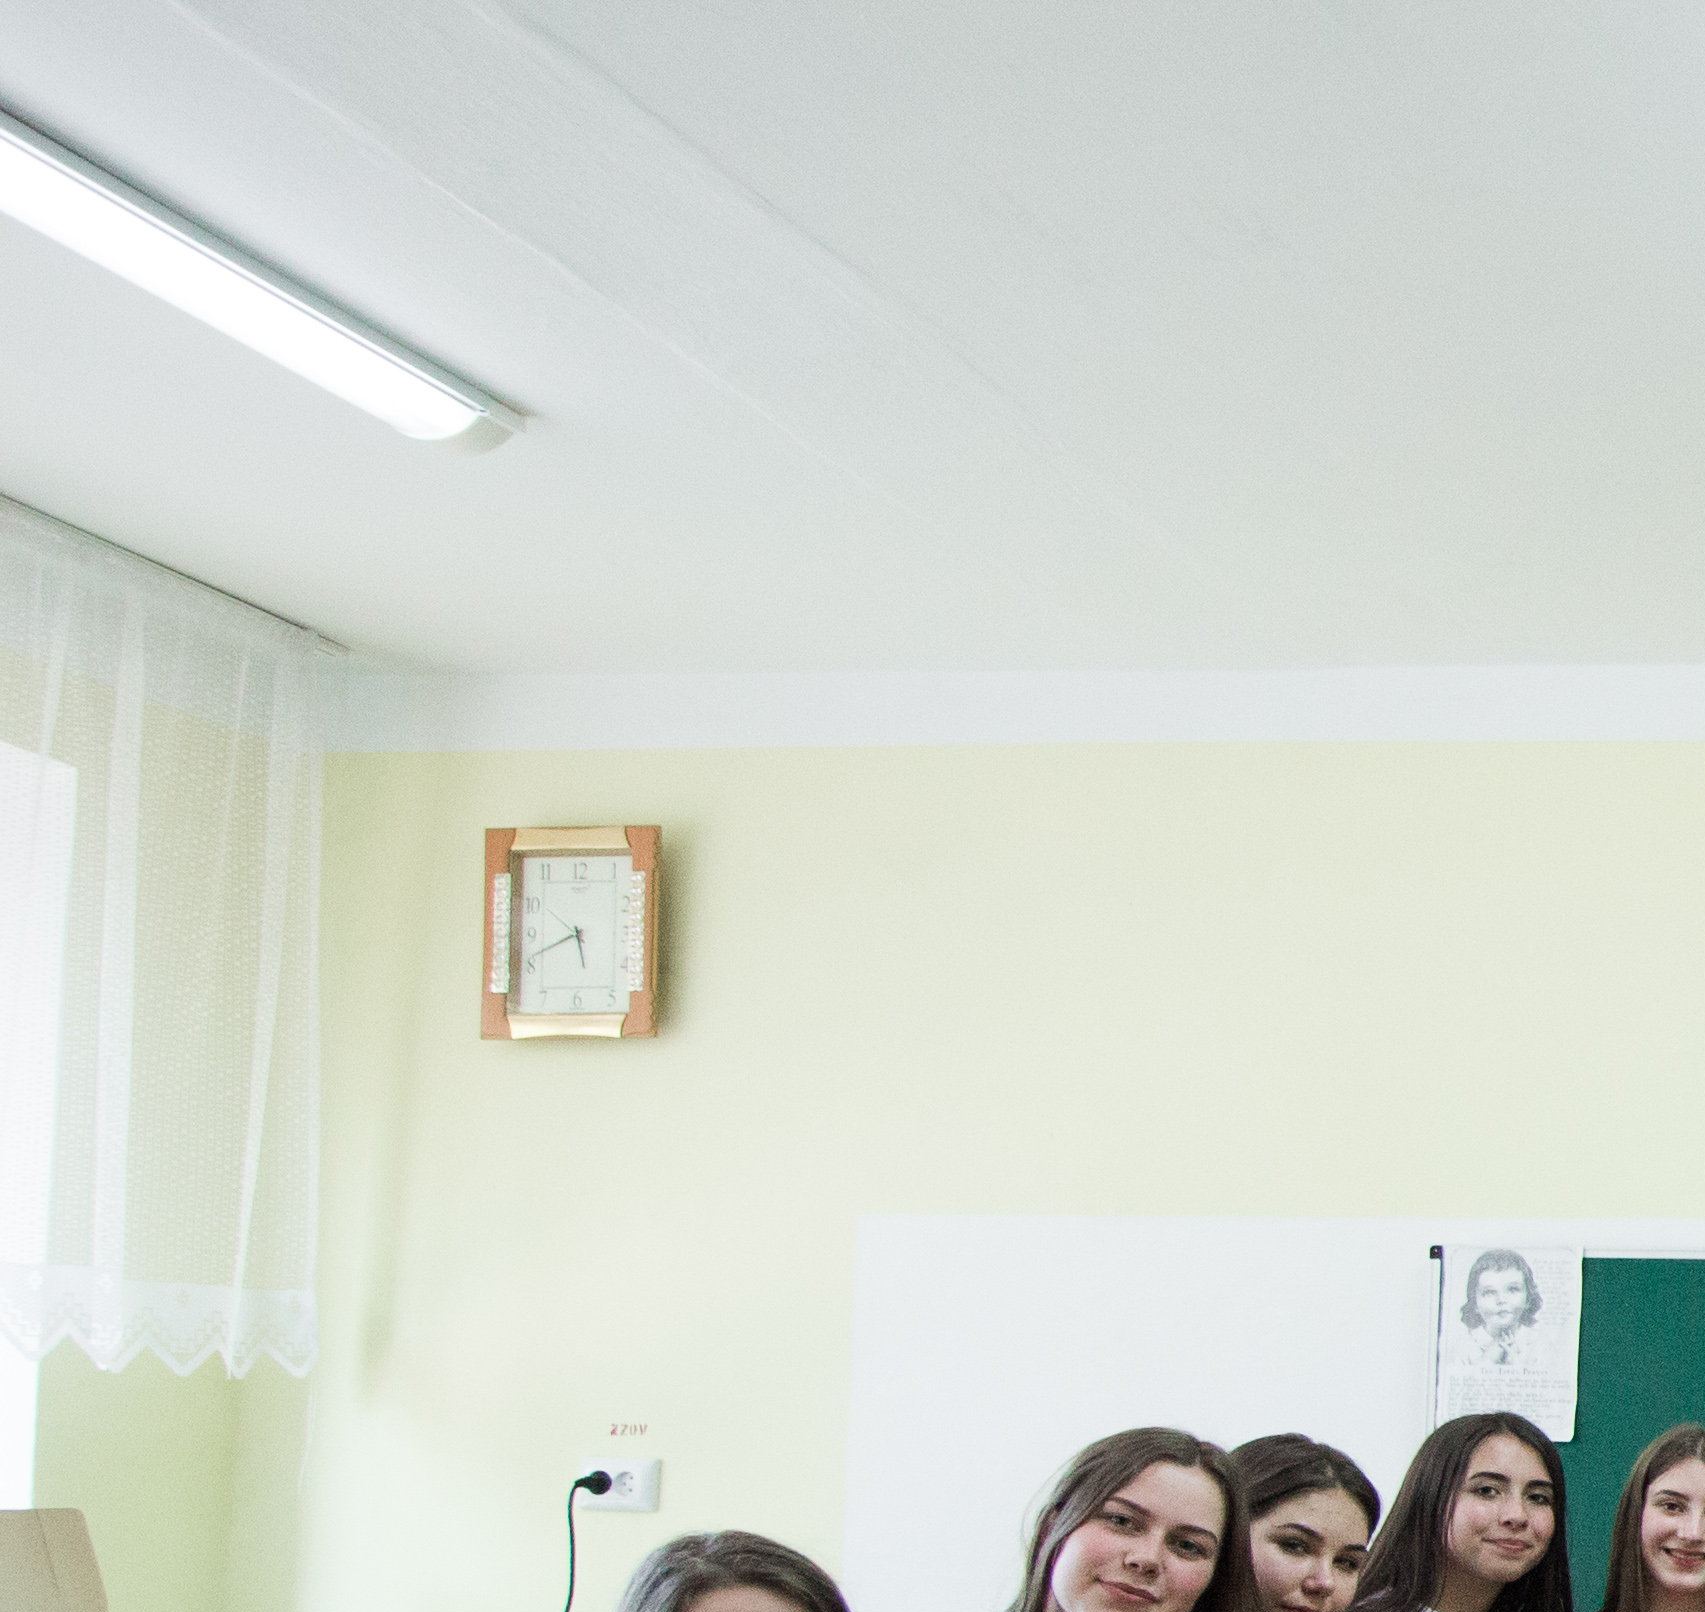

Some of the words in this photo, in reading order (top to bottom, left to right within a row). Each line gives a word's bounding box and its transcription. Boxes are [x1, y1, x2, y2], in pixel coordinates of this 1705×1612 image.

[573, 862, 588, 880] 12
[526, 897, 540, 914] 10
[527, 927, 537, 943] 9
[572, 990, 582, 1008] 6
